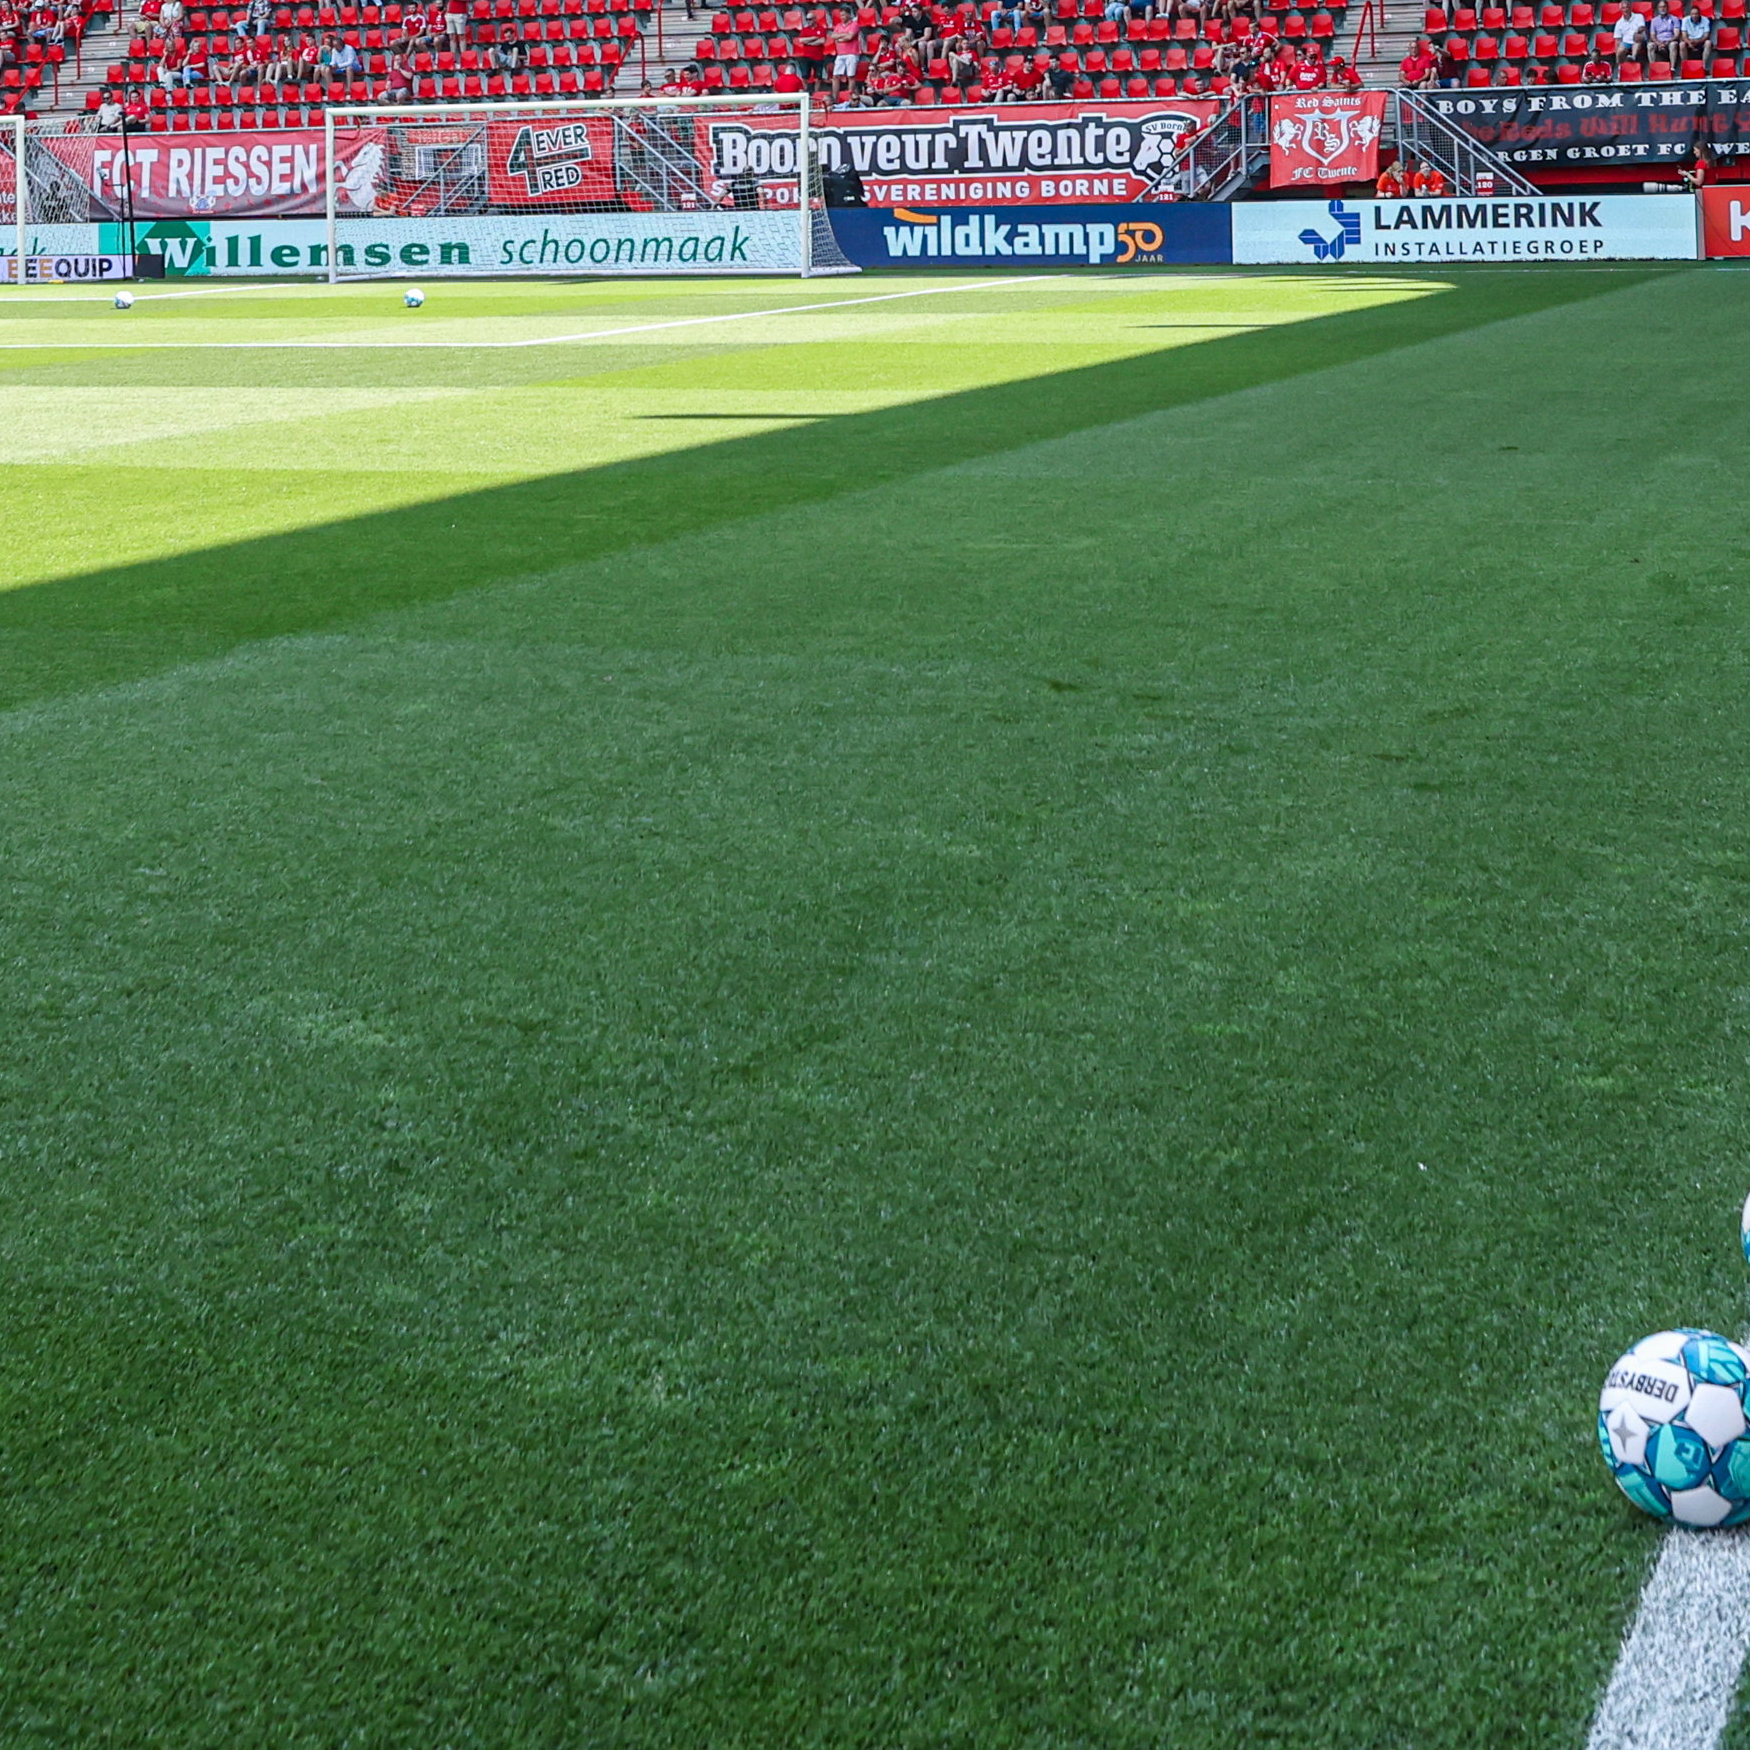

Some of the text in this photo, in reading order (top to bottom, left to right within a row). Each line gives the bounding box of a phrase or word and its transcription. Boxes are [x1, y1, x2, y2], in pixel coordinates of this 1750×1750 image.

[1321, 97, 1362, 108] Saints
[1437, 98, 1518, 116] BOYS
[1527, 93, 1624, 112] FROM
[1635, 89, 1707, 107] THE
[535, 123, 589, 154] EVER
[848, 135, 957, 174] veur
[958, 122, 1132, 170] Twente
[1567, 142, 1650, 160] GROET
[1657, 142, 1687, 158] FC
[93, 143, 319, 199] FCT RIESSEN
[508, 125, 542, 197] 4
[540, 164, 582, 191] RED
[1040, 177, 1128, 198] BORNE
[1375, 201, 1603, 231] LAMMERINK
[143, 225, 751, 269] Willemsen schoonmaak
[883, 213, 1115, 264] wildkamp
[1374, 239, 1604, 257] INSTALLATIEGROEP
[1134, 253, 1164, 263] JAAR
